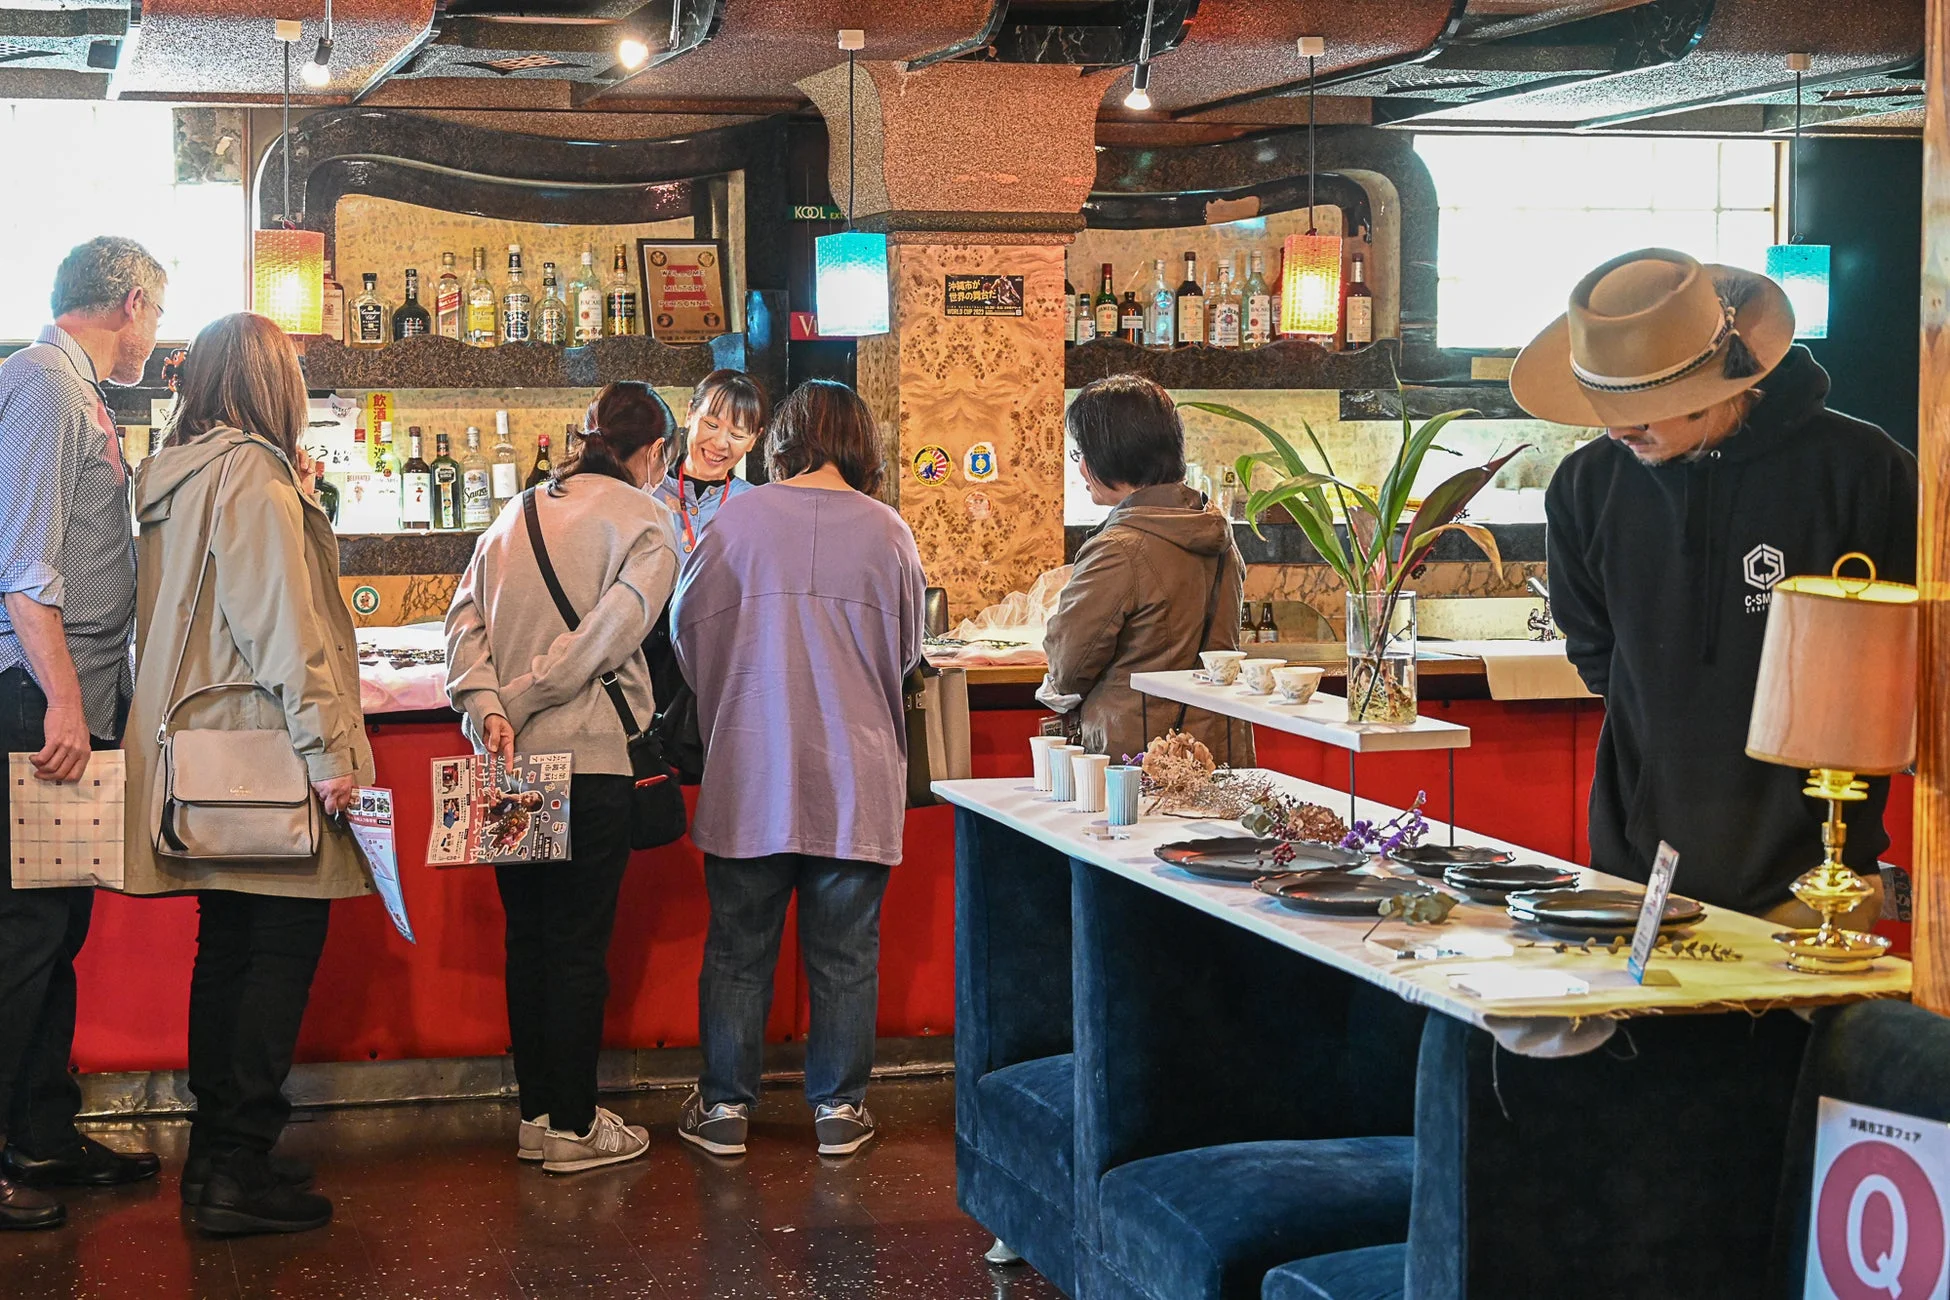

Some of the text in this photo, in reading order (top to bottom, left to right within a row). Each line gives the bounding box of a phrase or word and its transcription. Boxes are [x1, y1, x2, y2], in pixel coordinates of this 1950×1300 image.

[794, 206, 826, 219] KOOL
[949, 289, 997, 302] 世界の舞台だ
[1846, 1174, 1909, 1300] Q
